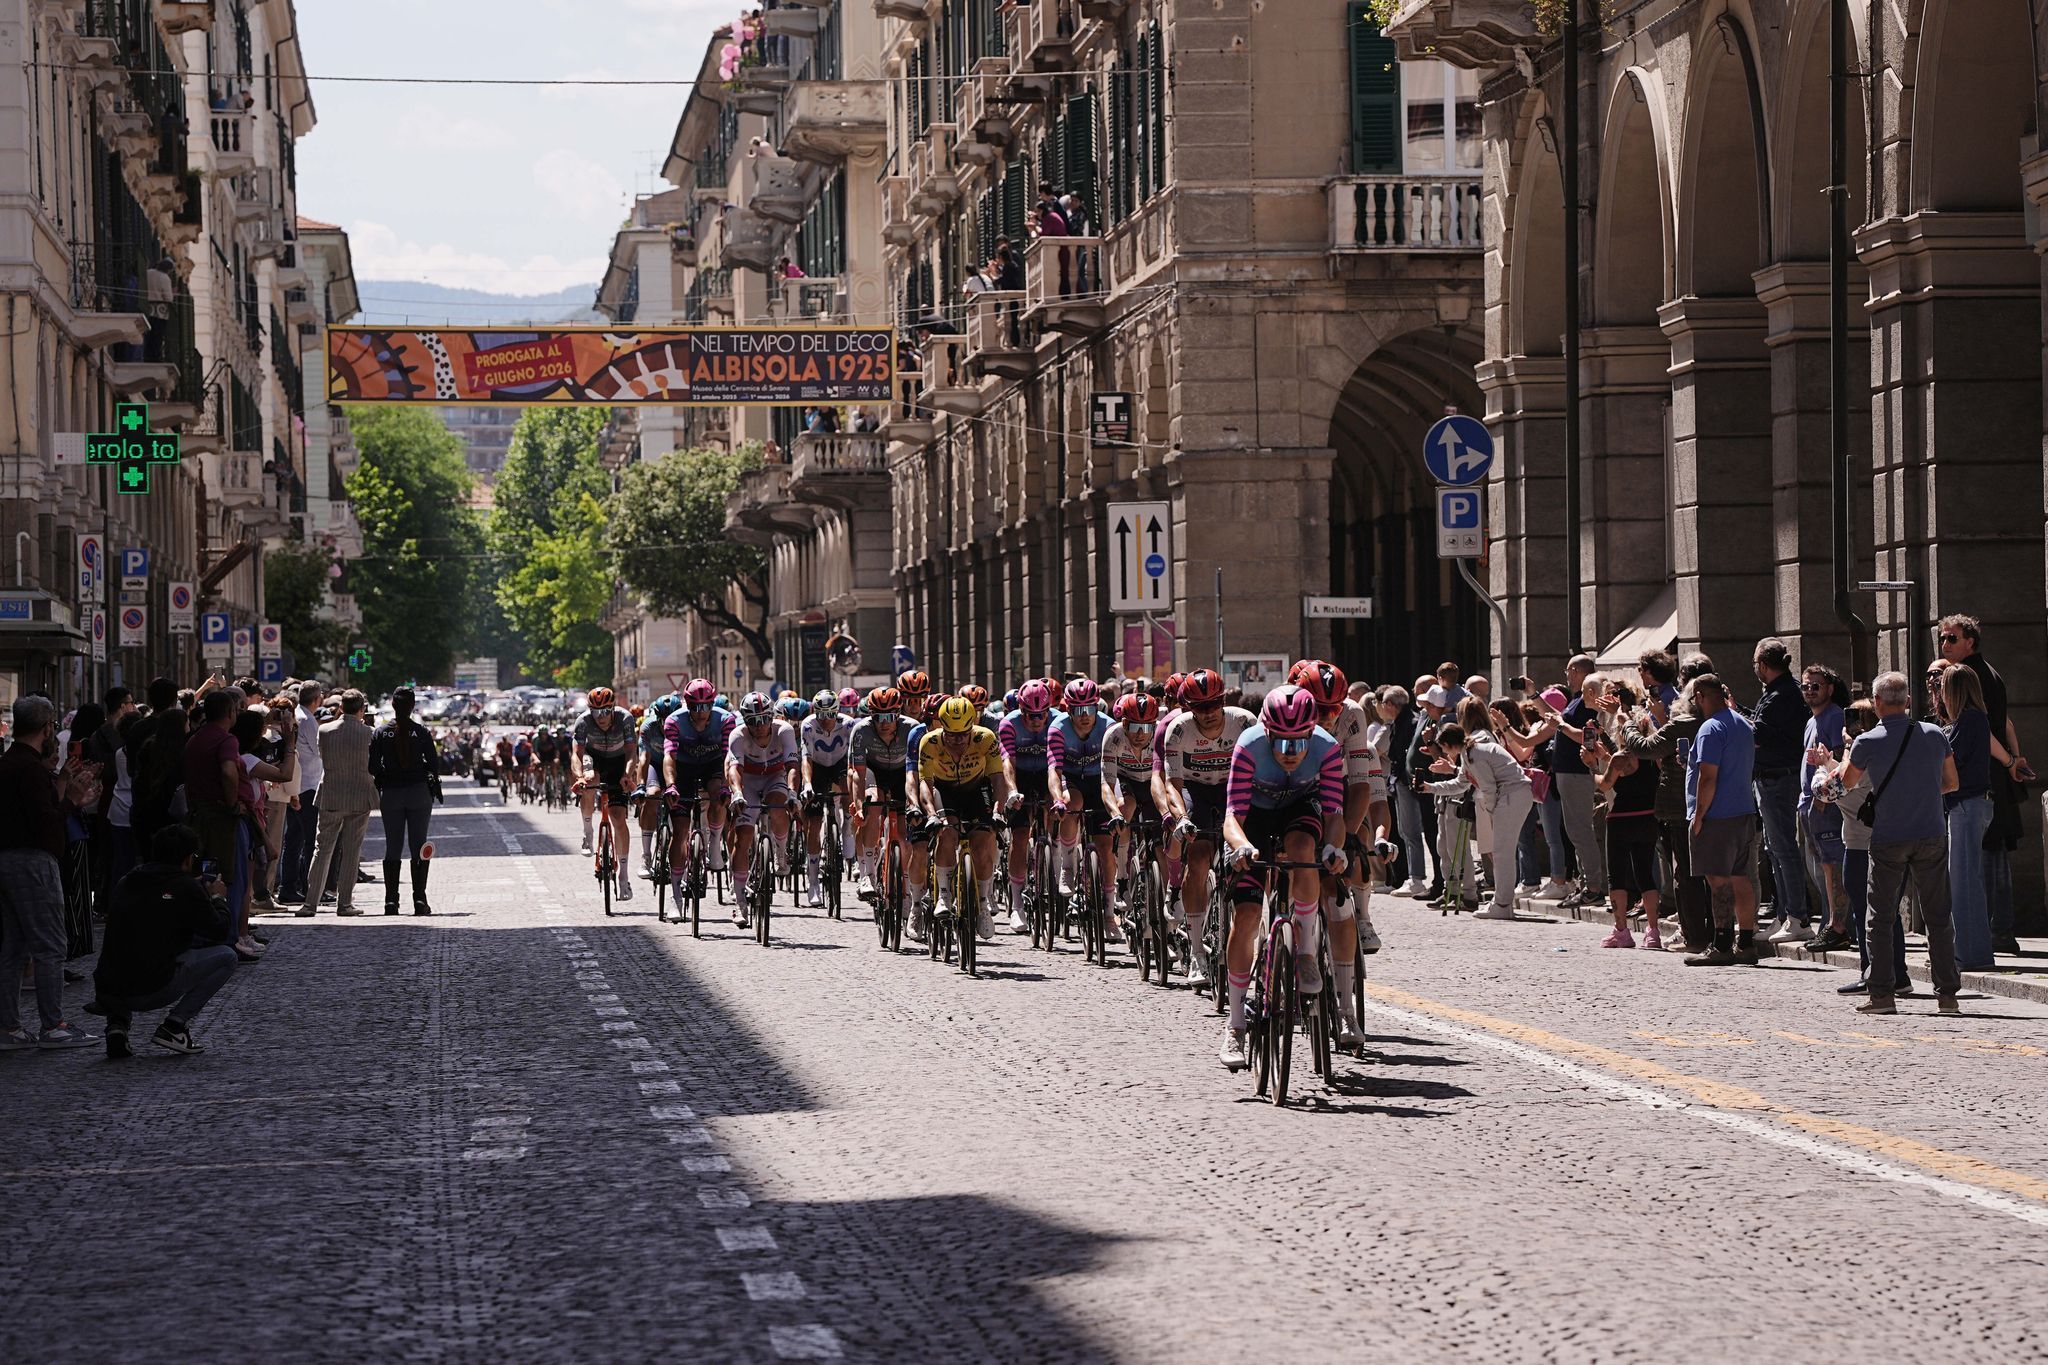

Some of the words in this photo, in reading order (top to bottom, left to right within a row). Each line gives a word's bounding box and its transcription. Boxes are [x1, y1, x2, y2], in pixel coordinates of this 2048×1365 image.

[690, 334, 723, 353] NEL
[729, 334, 795, 353] TEMPO
[800, 334, 829, 353] DEL
[836, 331, 890, 353] DÉCO
[475, 346, 544, 368] PROROGATA
[547, 344, 562, 358] AL
[471, 375, 479, 388] 7
[484, 367, 536, 386] GIUGNO
[539, 361, 572, 378] 2026
[692, 354, 822, 382] ALBISOLA
[827, 354, 890, 382] 1925
[714, 384, 729, 392] della
[730, 384, 760, 392] Ceramica
[761, 384, 768, 392] di
[769, 384, 791, 392] Savona
[1098, 396, 1124, 422] T
[151, 440, 175, 459] to
[1449, 497, 1471, 525] P
[127, 551, 145, 574] P
[1323, 606, 1367, 615] Mistrangelo
[207, 615, 225, 641] P
[263, 661, 278, 680] P
